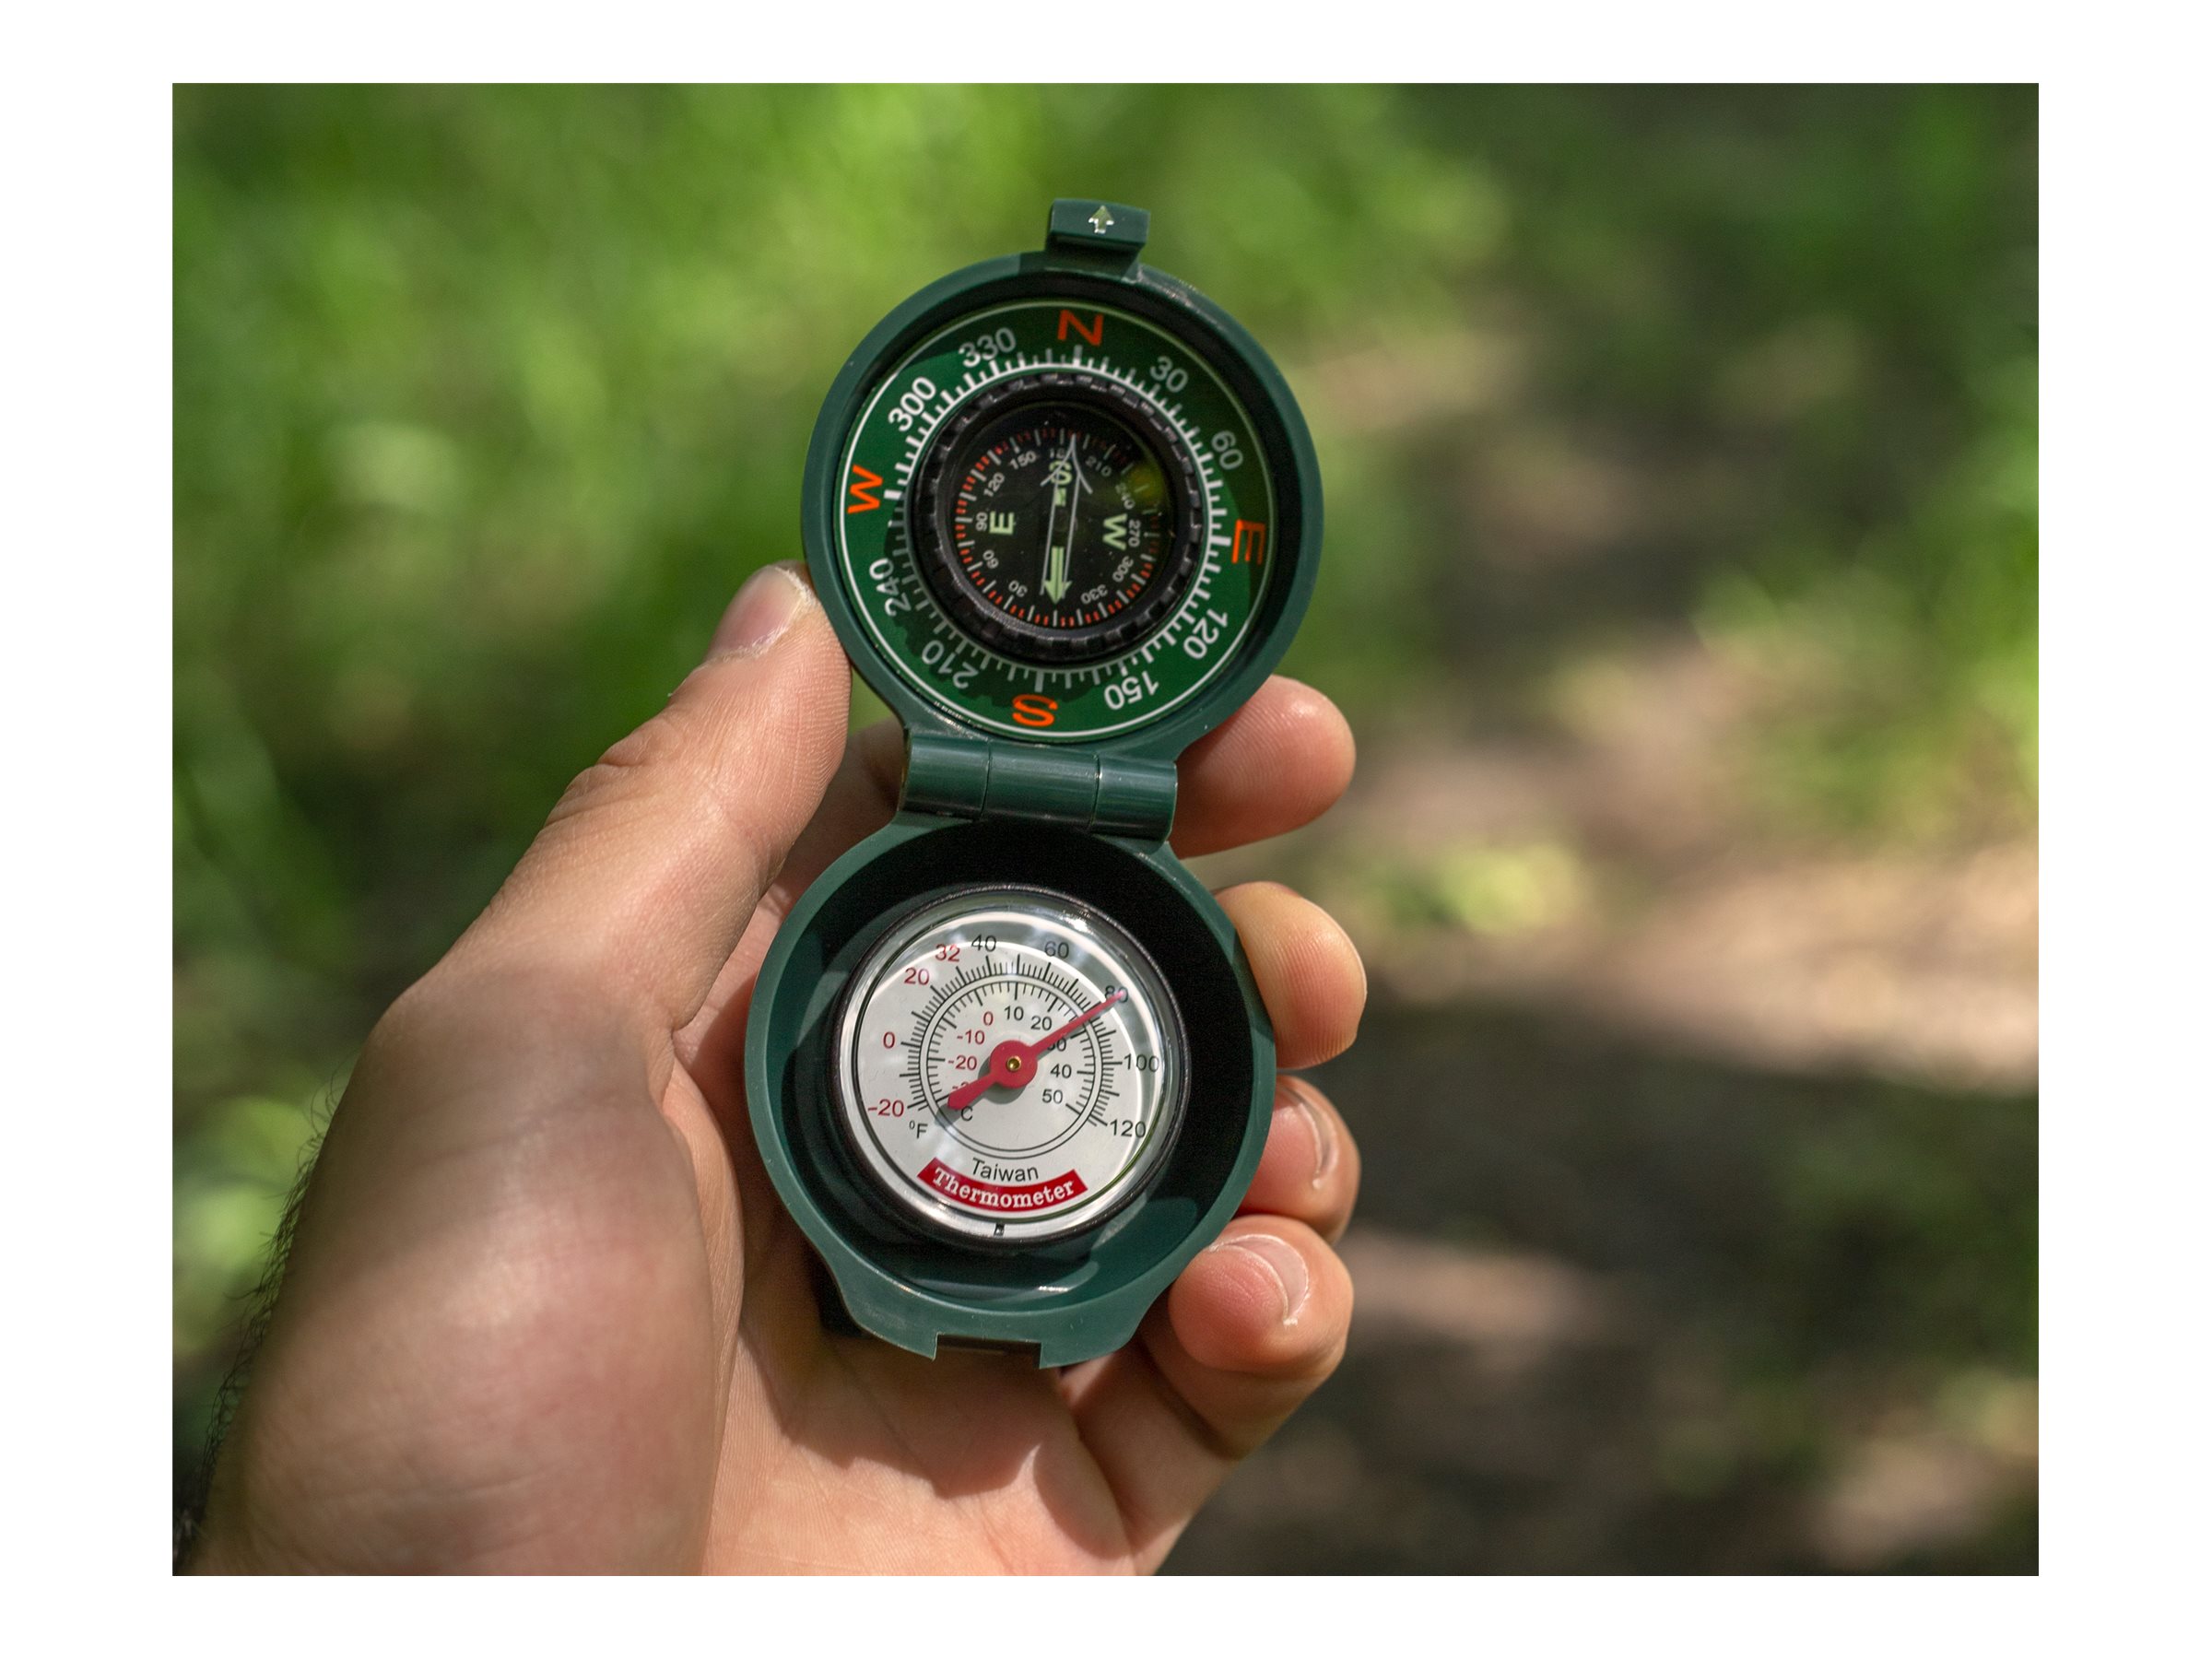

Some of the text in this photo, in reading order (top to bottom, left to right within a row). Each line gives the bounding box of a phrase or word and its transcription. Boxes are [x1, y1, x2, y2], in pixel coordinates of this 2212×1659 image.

[1057, 310, 1104, 346] N
[958, 327, 1018, 369] 330
[1149, 356, 1189, 394] 30
[888, 376, 936, 432] 300
[1009, 451, 1037, 470] 150
[1210, 429, 1244, 471] 60
[1049, 461, 1073, 486] S
[1085, 455, 1112, 477] 210
[846, 465, 884, 514] W
[983, 473, 1005, 497] 120
[1115, 482, 1135, 510] 240
[975, 512, 989, 532] 90
[989, 512, 1014, 535] E
[1102, 513, 1128, 551] W
[1128, 519, 1141, 547] 270
[1231, 519, 1266, 566] E
[982, 550, 999, 569] 60
[1112, 556, 1134, 582] 300
[868, 559, 912, 617] 240
[1007, 581, 1028, 597] 30
[1081, 583, 1108, 605] 330
[1183, 606, 1229, 659] 120
[921, 639, 980, 689] 210
[1103, 670, 1160, 711] 150
[1012, 694, 1059, 727] S
[935, 944, 960, 963] 32
[971, 934, 996, 952] 40
[1044, 941, 1070, 959] 60
[903, 968, 930, 986] 20
[982, 1011, 994, 1026] 0
[1004, 1006, 1024, 1021] 10
[1030, 1016, 1053, 1031] 20
[882, 1031, 896, 1049] 0
[956, 1030, 985, 1045] -10
[947, 1055, 978, 1070] -20
[1051, 1064, 1072, 1078] 40
[1123, 1055, 1159, 1073] 100
[1041, 1089, 1064, 1104] 50
[867, 1100, 905, 1118] -20
[1110, 1120, 1147, 1138] 120
[971, 1157, 1039, 1182] Taiwan
[933, 1169, 1075, 1209] Thermometer
